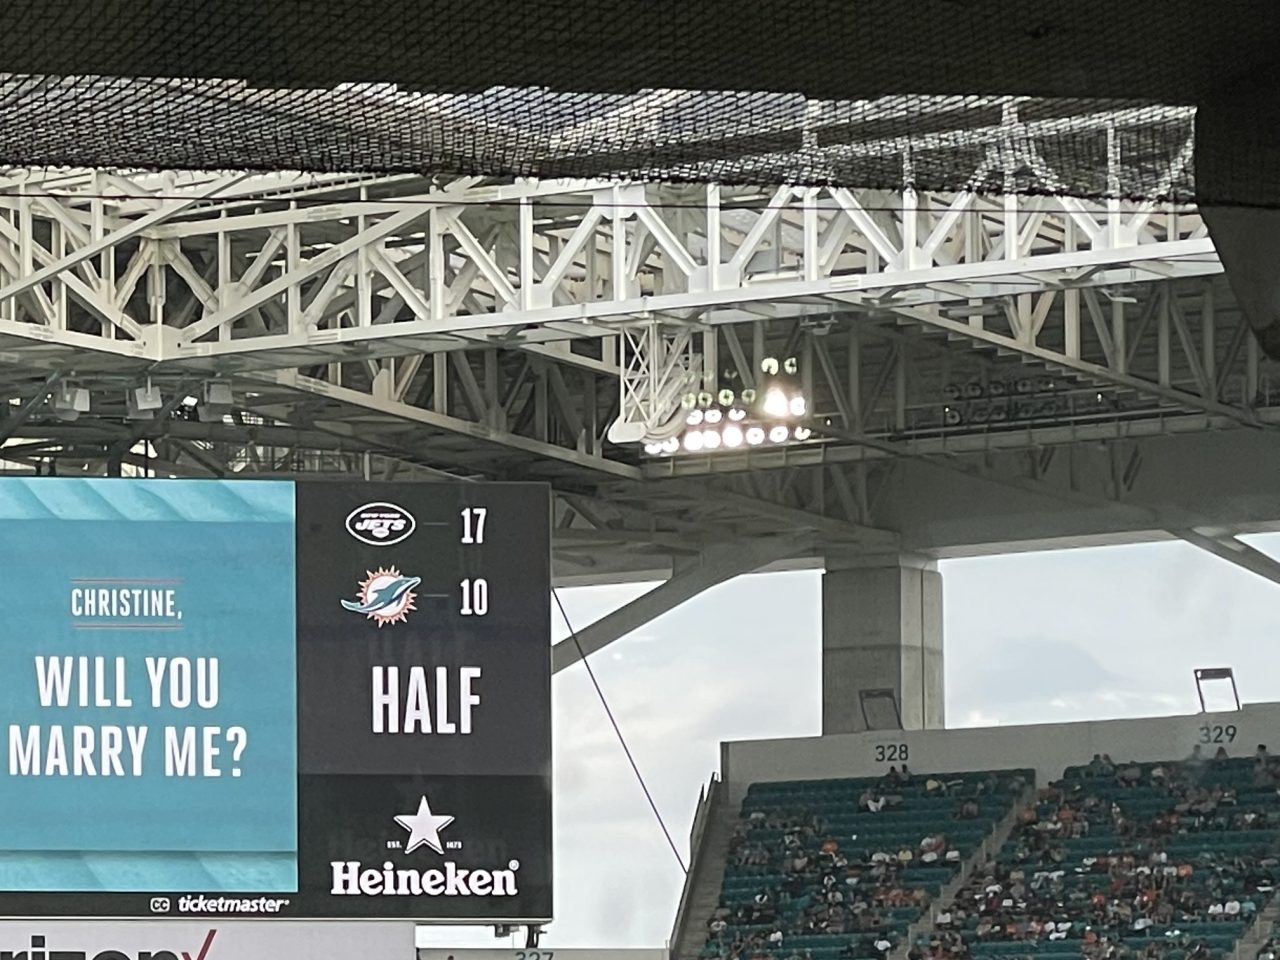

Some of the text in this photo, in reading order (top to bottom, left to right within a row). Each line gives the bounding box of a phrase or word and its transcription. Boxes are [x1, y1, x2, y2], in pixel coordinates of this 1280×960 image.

[355, 519, 407, 531] JETS
[461, 507, 487, 544] 17
[71, 588, 182, 620] CHRISTINE,
[460, 578, 488, 616] 10
[34, 655, 219, 709] WILL YOU
[372, 666, 481, 734] HALF
[8, 724, 248, 778] MARRY ME?
[1199, 725, 1237, 744] 329
[875, 744, 908, 762] 328
[330, 861, 518, 896] Heineken
[178, 895, 285, 913] ticketmaster
